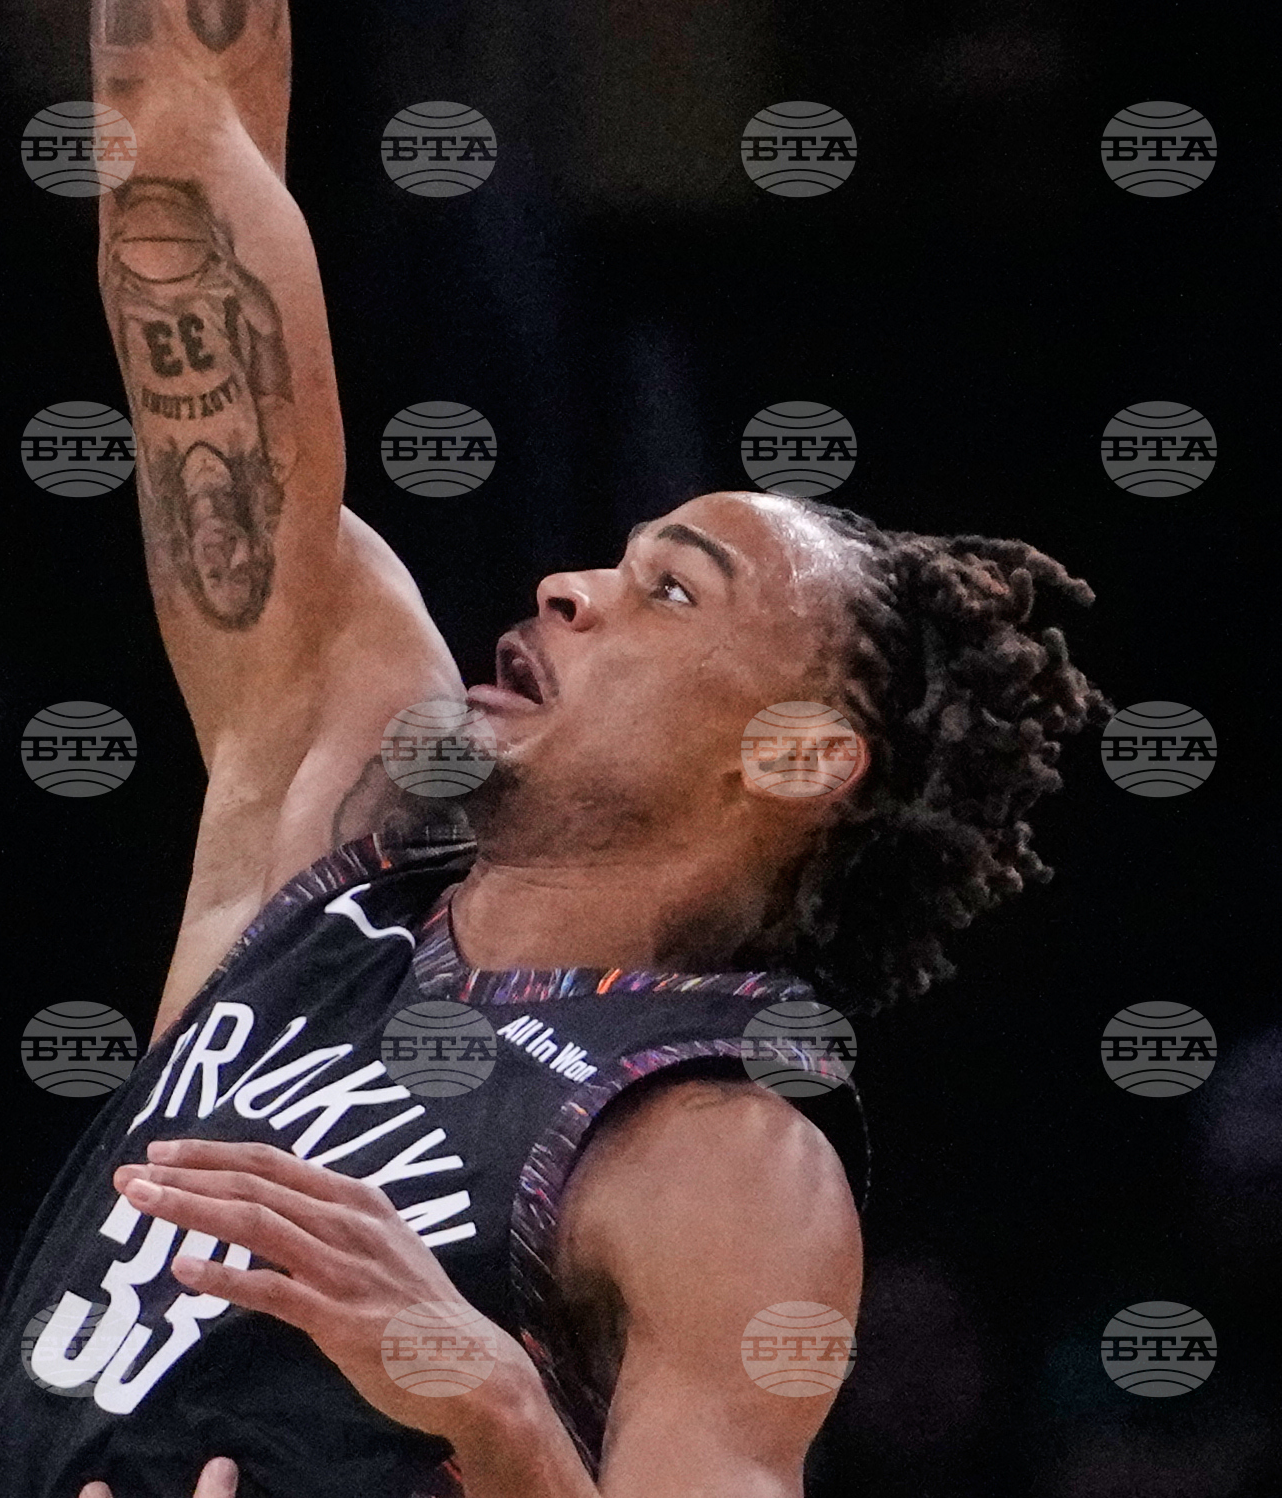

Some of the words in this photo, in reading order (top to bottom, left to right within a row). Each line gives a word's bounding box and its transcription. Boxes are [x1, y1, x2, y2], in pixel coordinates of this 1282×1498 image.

[496, 1015, 544, 1046] All
[525, 1027, 558, 1063] In
[549, 1041, 598, 1083] Won
